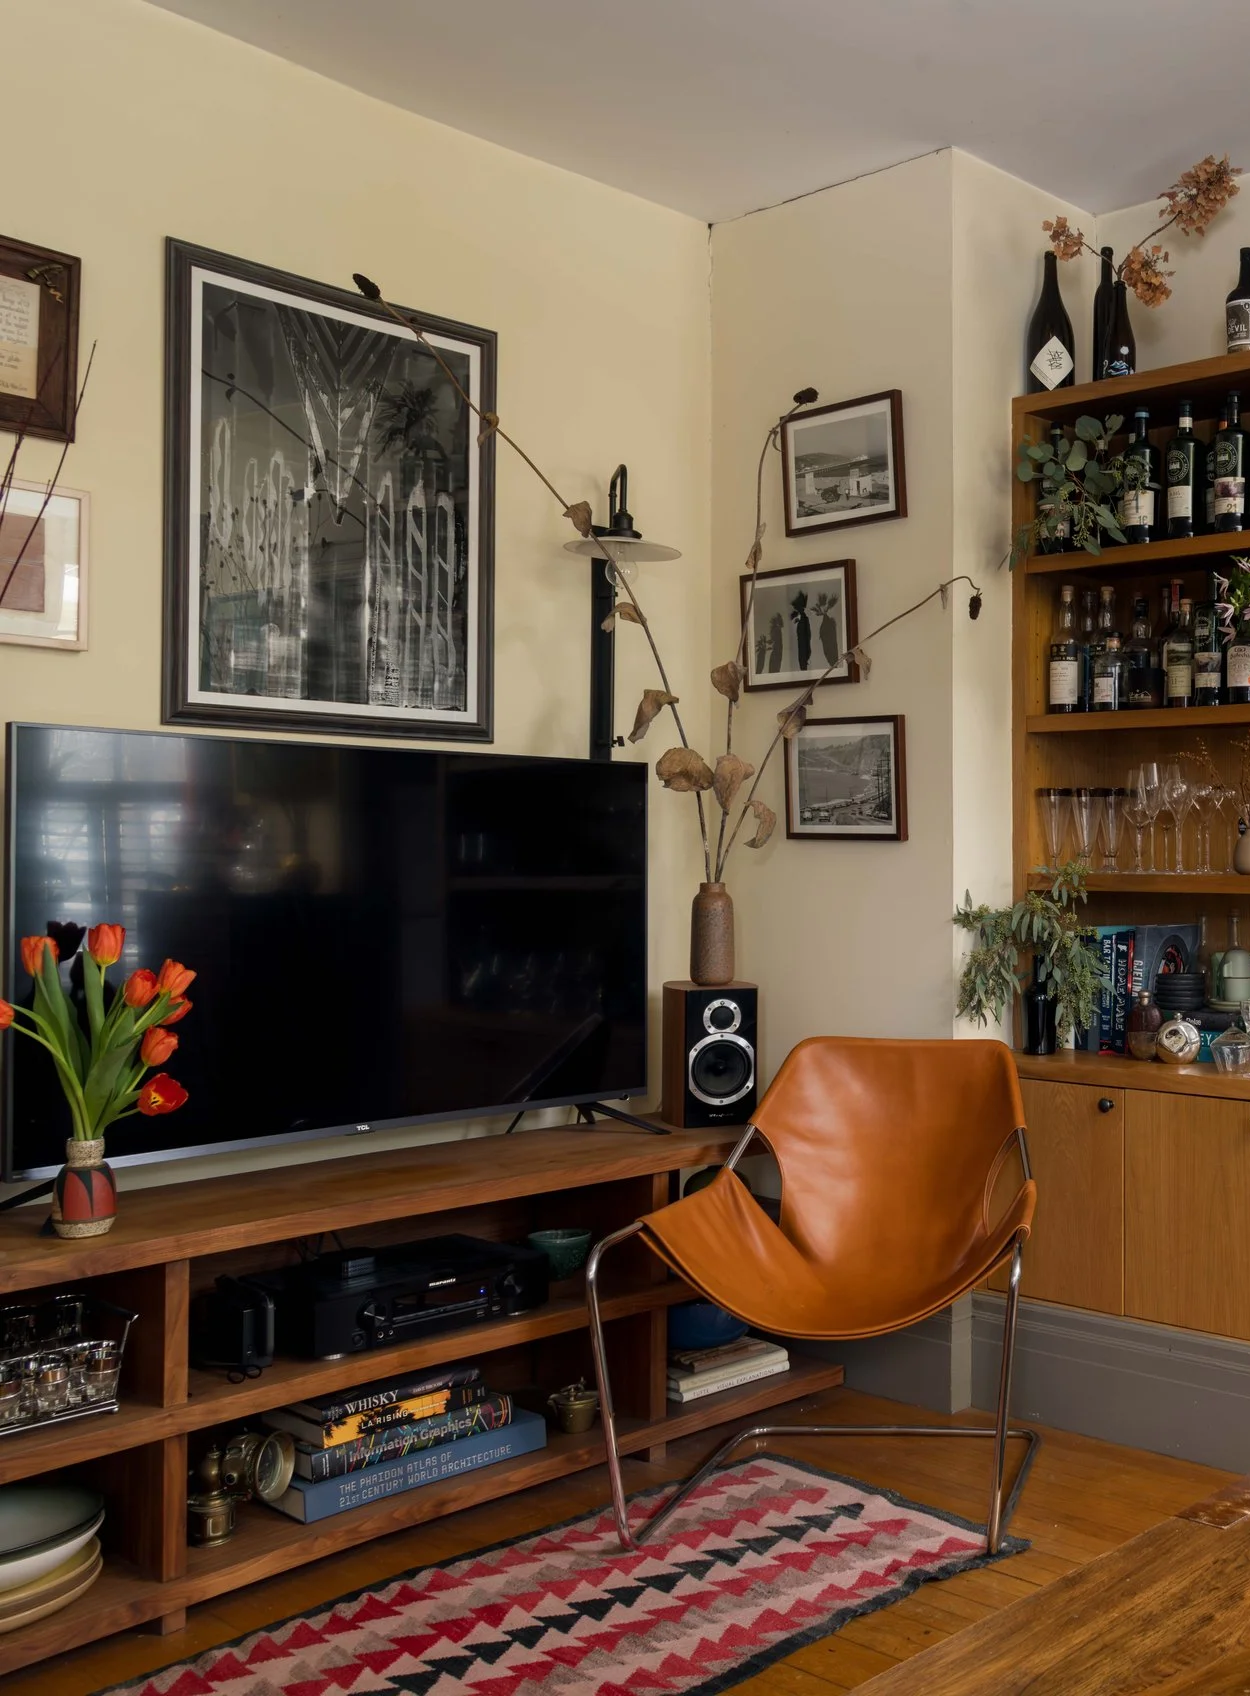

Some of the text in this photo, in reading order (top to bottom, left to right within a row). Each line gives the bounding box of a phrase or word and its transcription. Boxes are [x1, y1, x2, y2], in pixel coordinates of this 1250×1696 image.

[344, 1390, 400, 1415] WHISKY
[360, 1408, 410, 1430] LA RISING
[348, 1417, 473, 1463] Information Graphics
[340, 1451, 453, 1496] THE PHAIDON ATLAS OF
[362, 1477, 404, 1499] CENTURY
[408, 1468, 439, 1486] WORLD
[441, 1444, 512, 1474] ARCHITECTURE
